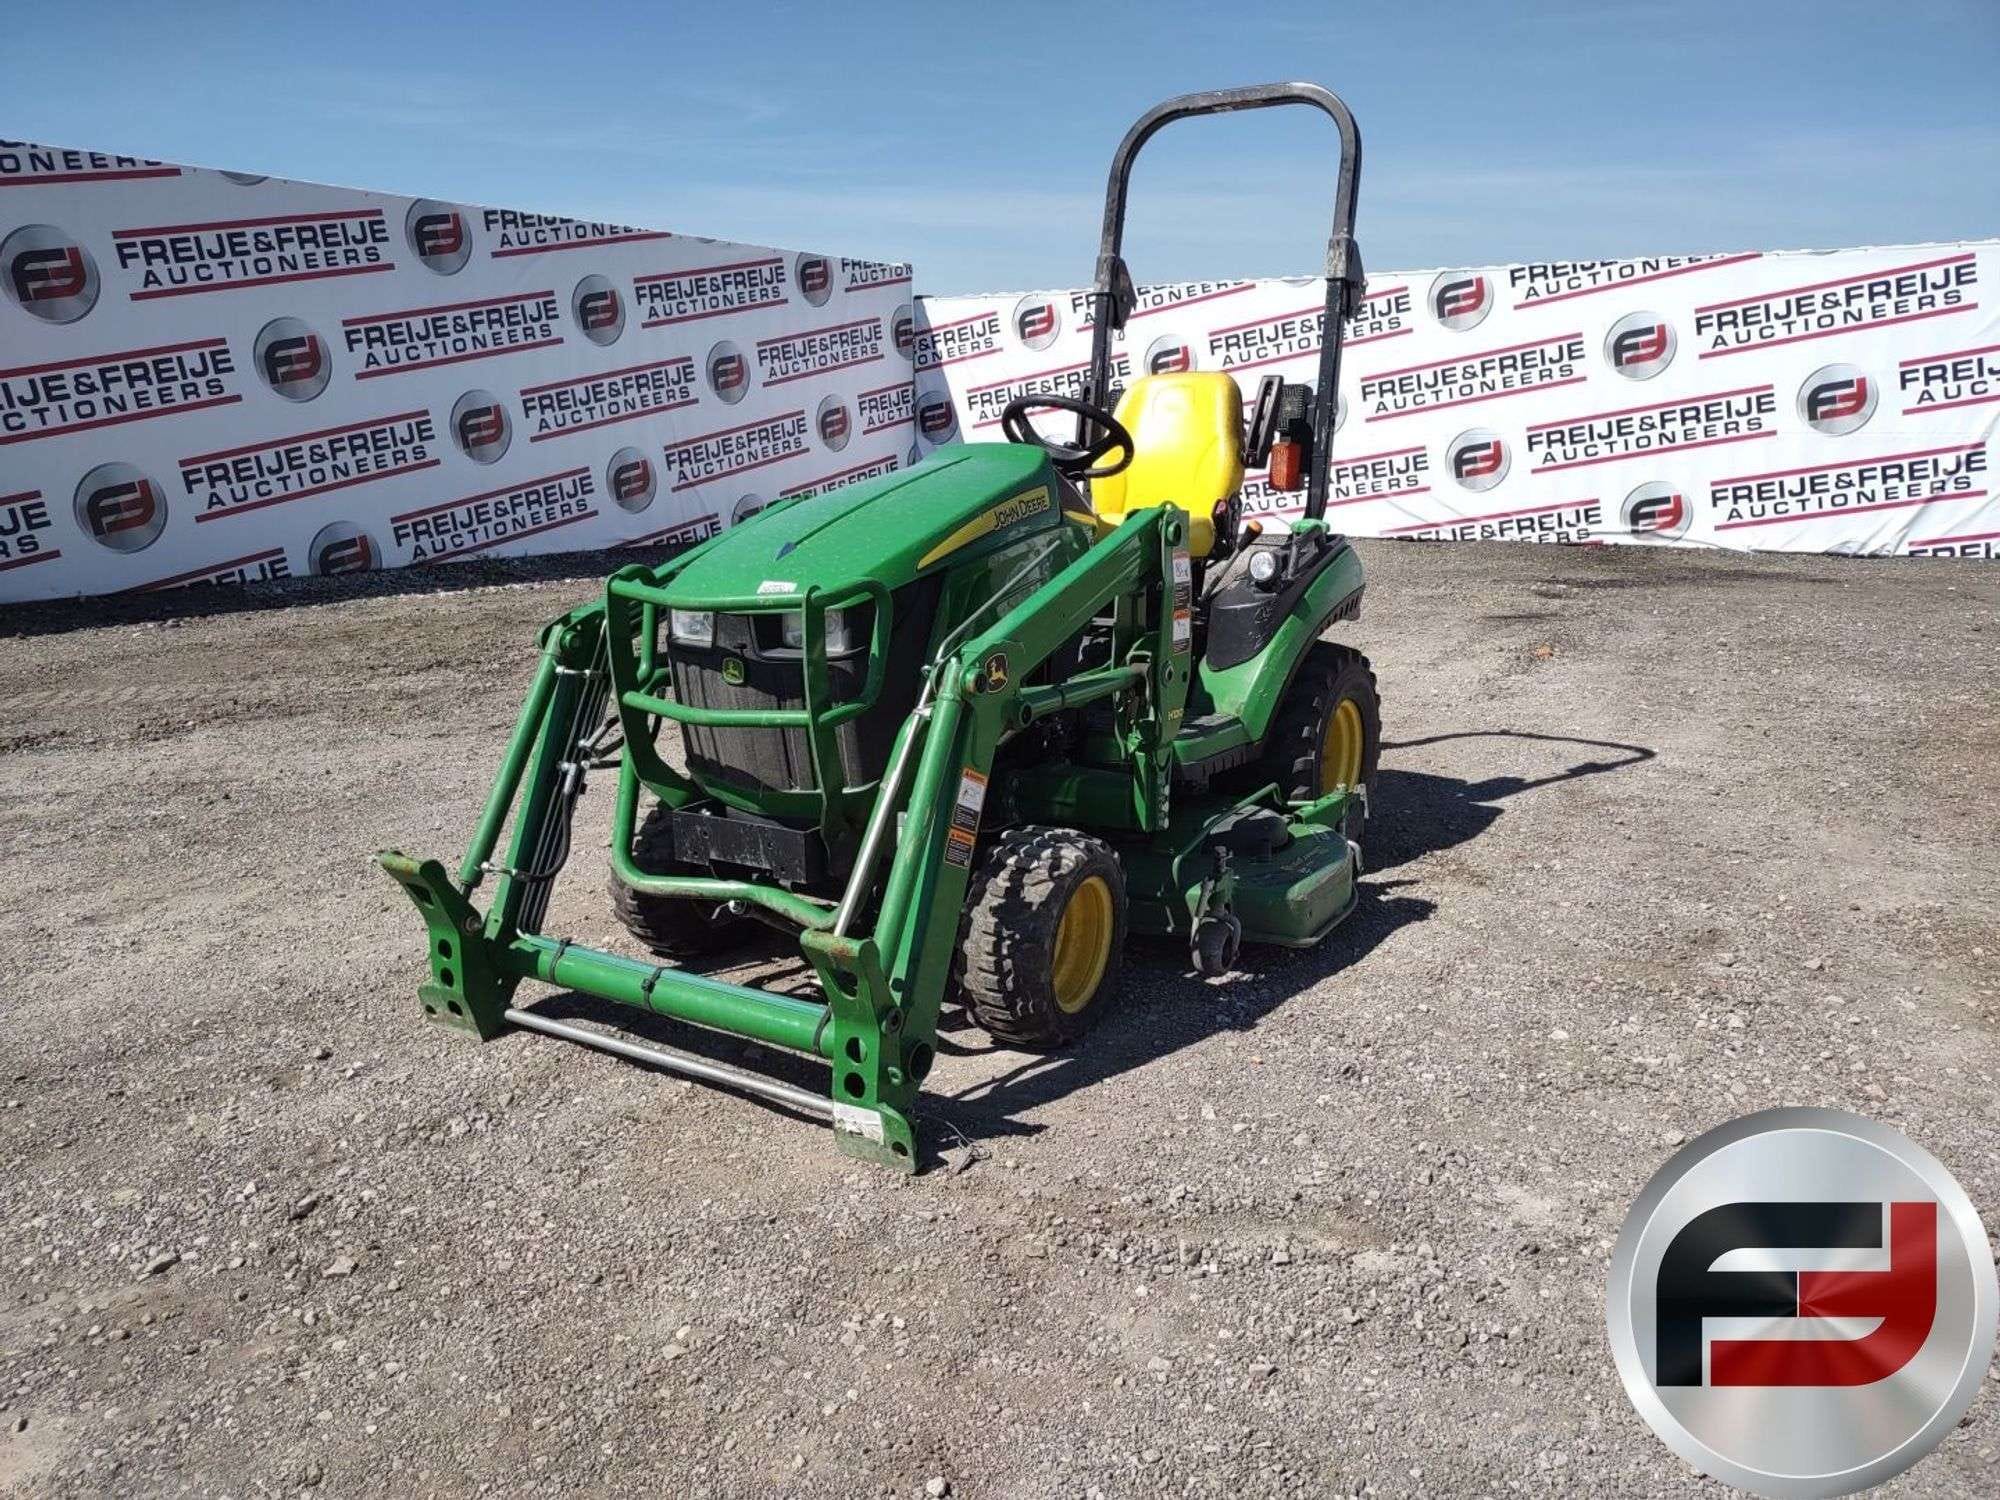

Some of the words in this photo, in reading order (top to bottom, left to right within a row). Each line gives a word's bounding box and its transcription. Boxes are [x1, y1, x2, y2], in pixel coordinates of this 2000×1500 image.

[115, 219, 390, 269] FREIJE&FREIJE
[143, 245, 381, 288] AUCTIONEERS
[635, 265, 787, 305] FREIJE&FREIJE
[648, 286, 781, 320] AUCTIONEERS
[1695, 262, 1978, 336] FREIJE&FREIJE
[344, 298, 560, 352] FREIJE&FREIJE
[757, 323, 883, 367] FREIJE&FREIJE
[1712, 289, 1962, 350] AUCTIONEERS
[365, 323, 553, 368] AUCTIONEERS
[768, 343, 879, 379] AUCTIONEERS
[1361, 340, 1586, 402] FREIJE&FREIJE
[522, 363, 696, 419] FREIJE&FREIJE
[539, 386, 690, 432] AUCTIONEERS
[1375, 363, 1574, 414] AUCTIONEERS
[665, 416, 808, 471] FREIJE&FREIJE
[1527, 392, 1776, 452] FREIJE&FREIJE
[1542, 416, 1762, 465] AUCTIONEERS
[182, 419, 435, 494] FREIJE&FREIJE
[207, 445, 427, 510] AUCTIONEERS
[677, 437, 803, 483] AUCTIONEERS
[1711, 450, 1988, 508] FREIJE&FREIJE
[393, 475, 595, 548] FREIJE&FREIJE
[994, 504, 1019, 528] JOHN
[1727, 476, 1972, 521] AUCTIONEERS
[412, 498, 588, 561] AUCTIONEERS
